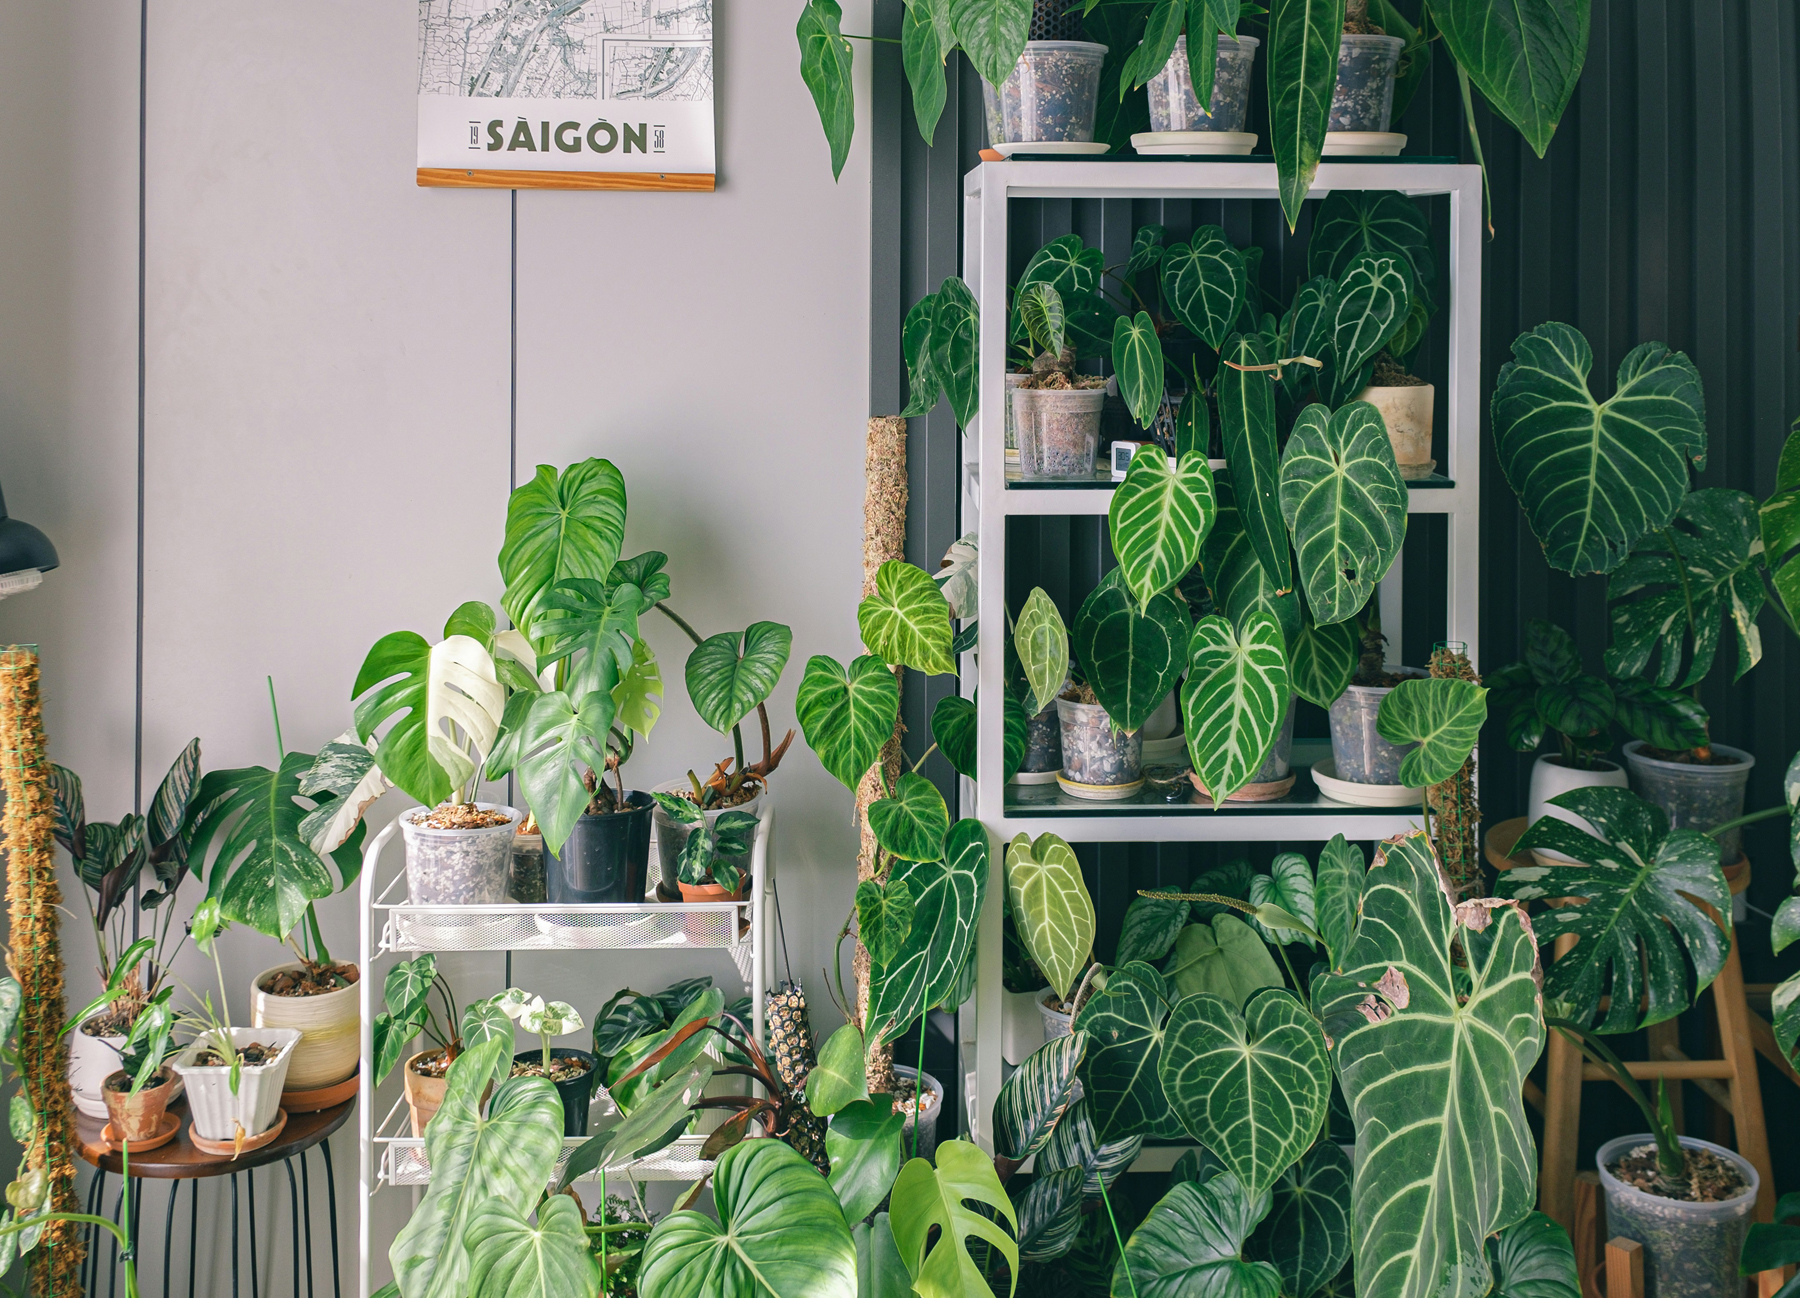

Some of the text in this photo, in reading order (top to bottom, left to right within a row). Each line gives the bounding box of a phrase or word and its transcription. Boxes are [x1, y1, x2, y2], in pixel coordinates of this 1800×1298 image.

[470, 116, 665, 154] 19 SÀIGÒN 58
